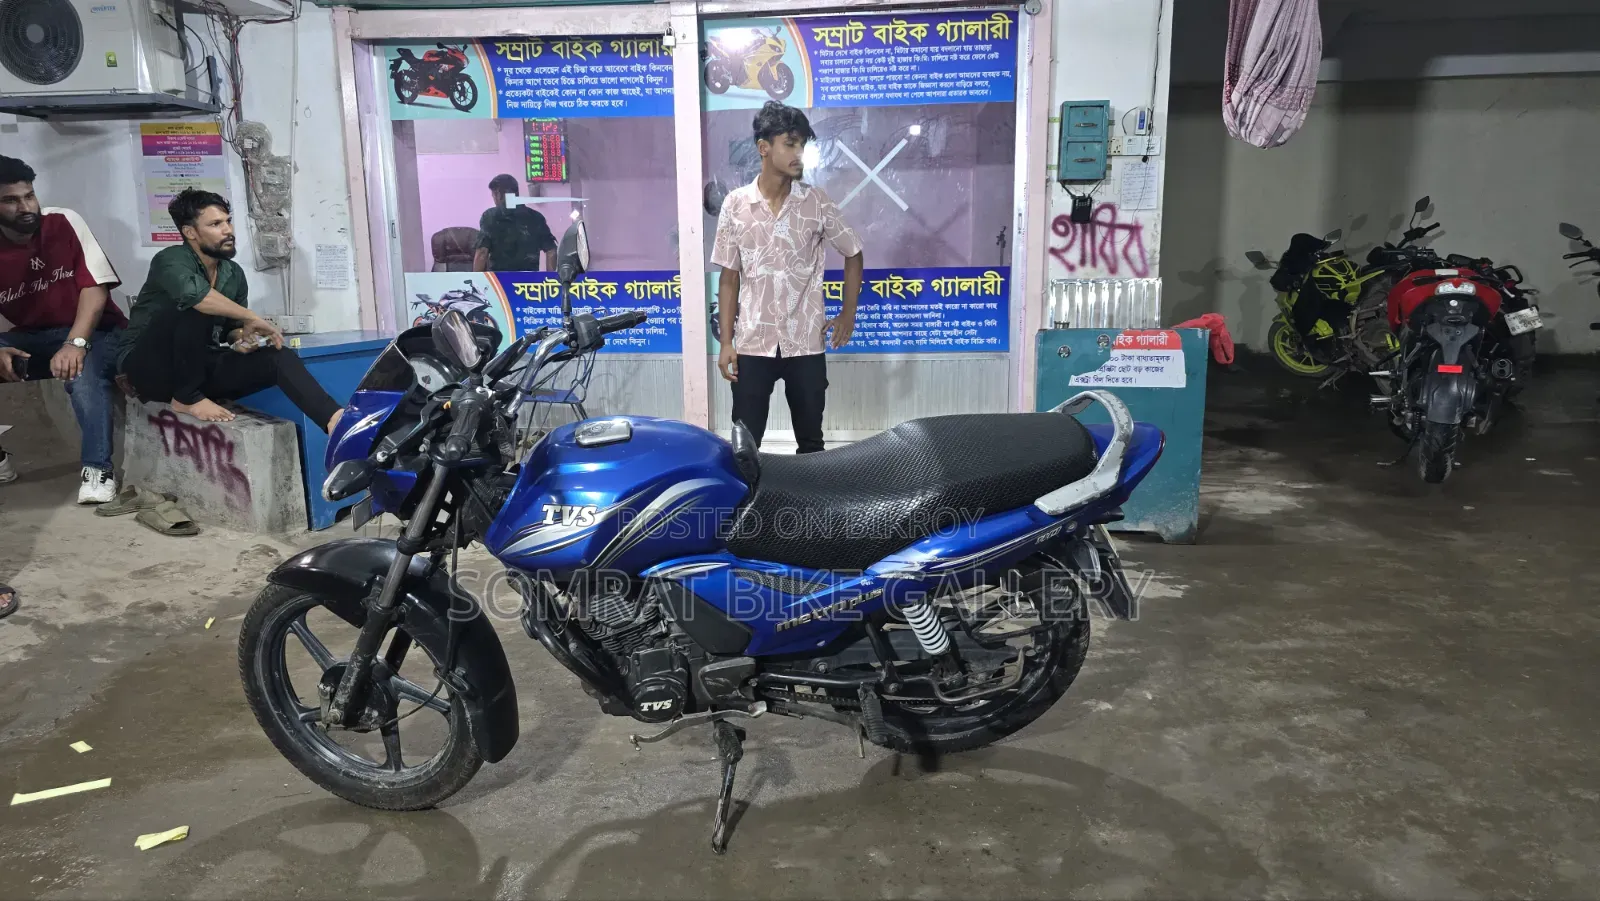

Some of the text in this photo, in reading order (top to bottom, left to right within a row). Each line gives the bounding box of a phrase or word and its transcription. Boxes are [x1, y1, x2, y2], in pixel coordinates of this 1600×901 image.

[812, 12, 1013, 49] সম্রাট বাইক গ্যালারী
[494, 37, 673, 62] সম্রাট বাইক গ্যালার
[512, 277, 561, 302] সম্রাট
[569, 277, 618, 301] বাইক
[870, 274, 925, 299] বাইক
[931, 270, 1004, 297] গ্যালারী
[1136, 332, 1168, 345] গ্যালারী
[1106, 374, 1120, 384] দিতে
[1118, 365, 1130, 373] ছোট
[541, 504, 598, 527] TVS
[640, 699, 672, 711] TVS
